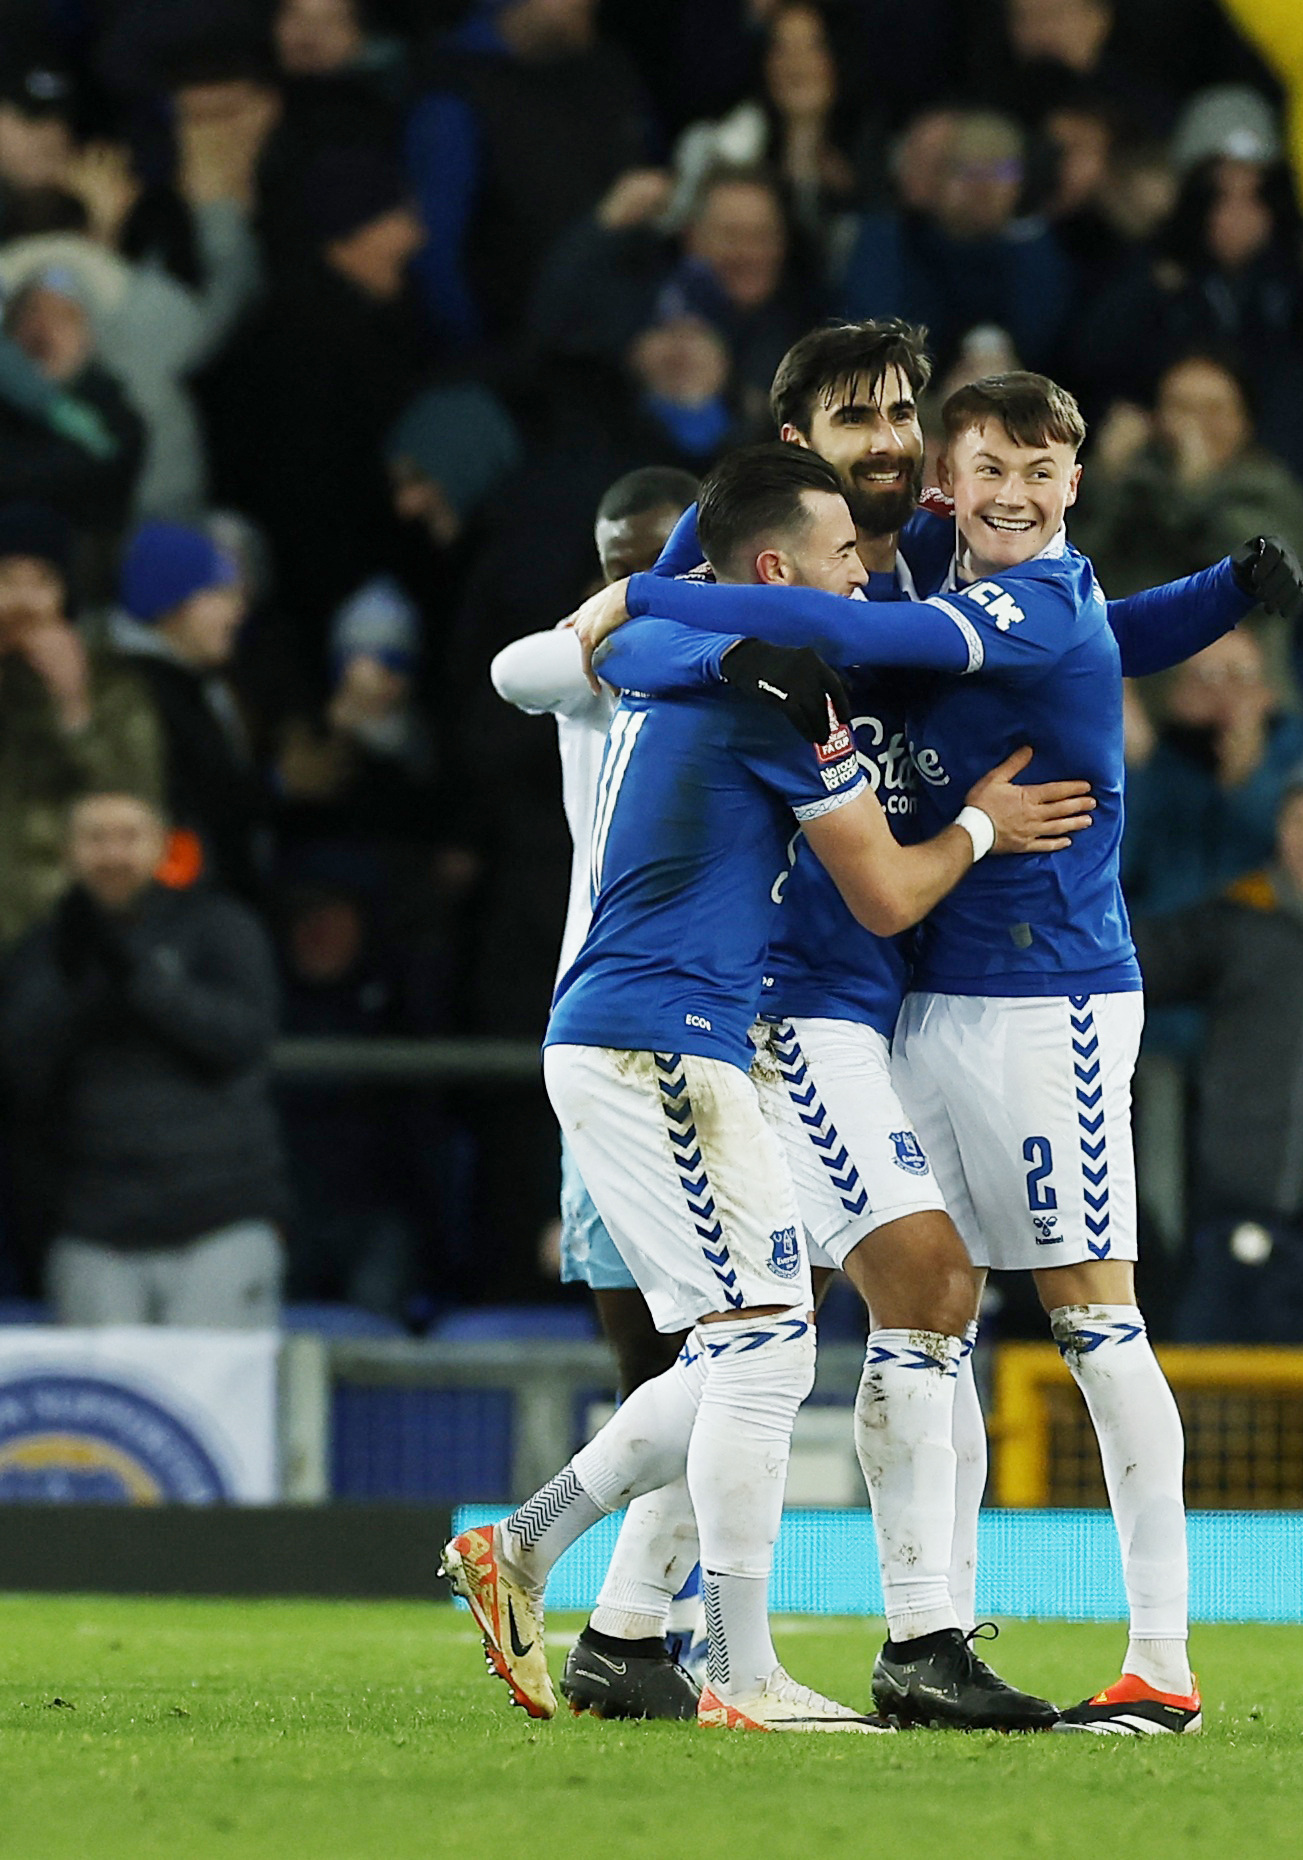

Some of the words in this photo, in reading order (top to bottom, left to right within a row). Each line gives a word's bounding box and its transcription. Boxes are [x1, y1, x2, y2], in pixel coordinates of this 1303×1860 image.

[821, 743, 836, 755] FA
[834, 736, 850, 751] CUP
[820, 766, 838, 780] No
[591, 710, 648, 897] 11
[1022, 1135, 1058, 1212] 2
